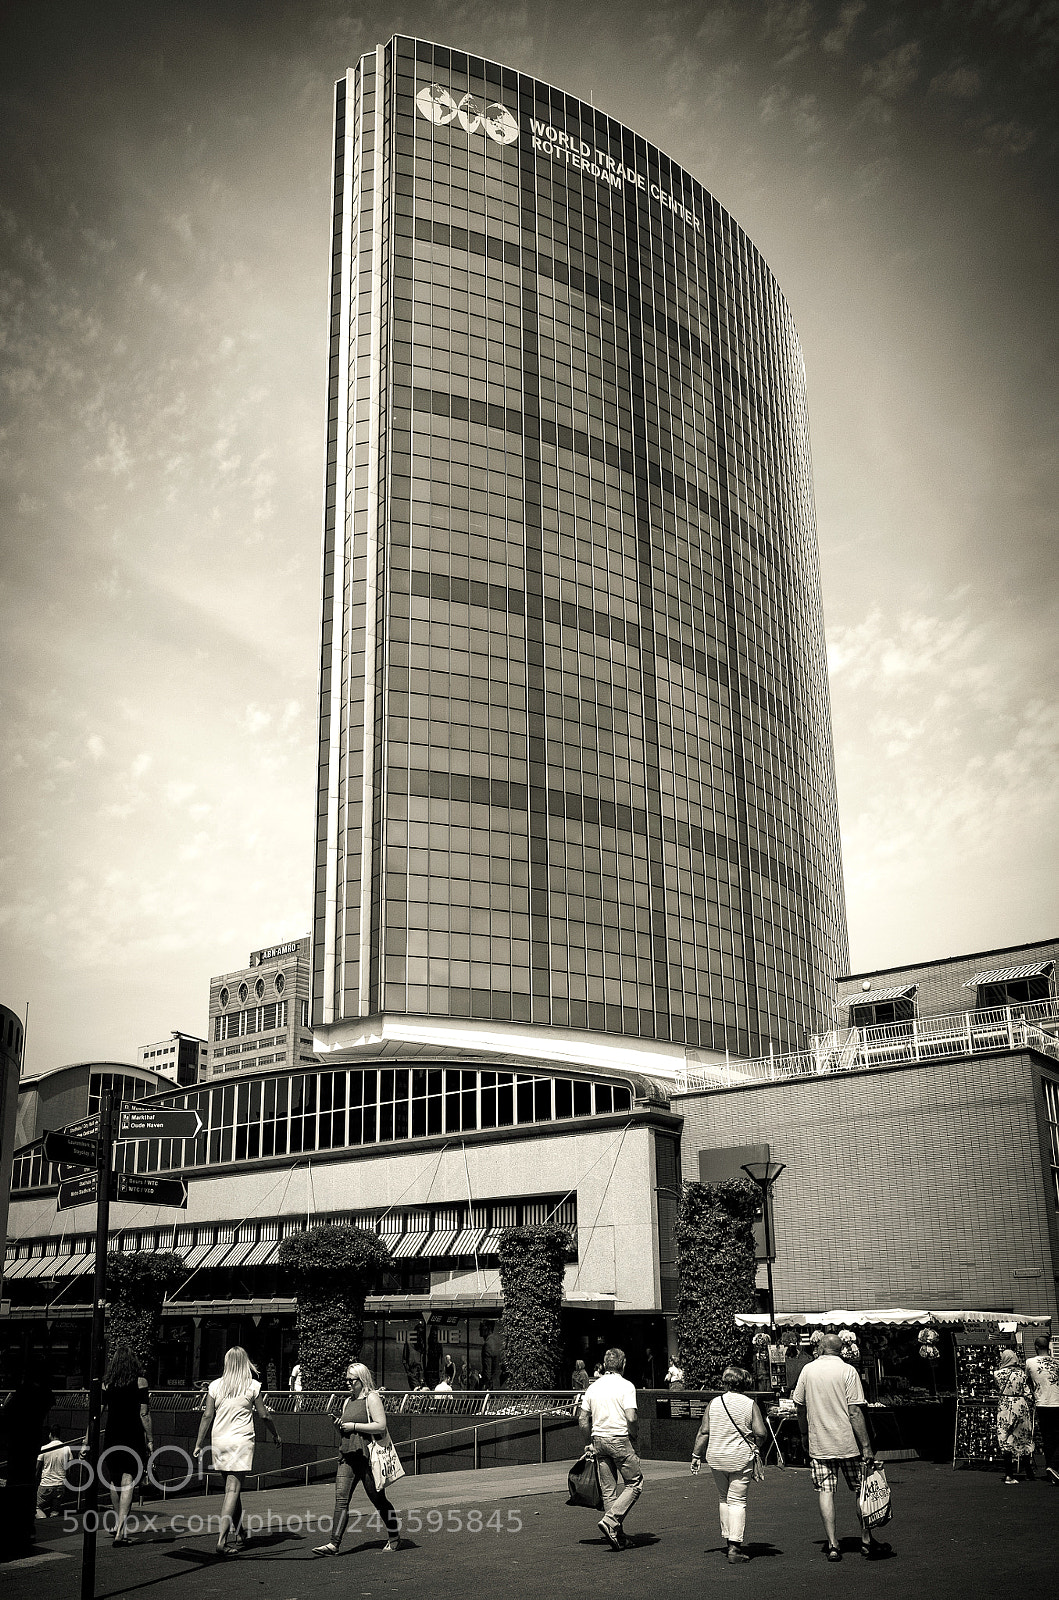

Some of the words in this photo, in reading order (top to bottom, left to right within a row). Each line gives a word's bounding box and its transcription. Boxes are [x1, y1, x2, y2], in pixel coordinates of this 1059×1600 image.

[529, 118, 591, 158] WORLD
[595, 149, 646, 192] TRADE
[650, 183, 701, 232] CENTER
[531, 135, 622, 190] ROTTERDAM
[396, 1330, 418, 1344] WE
[437, 1329, 460, 1344] WE
